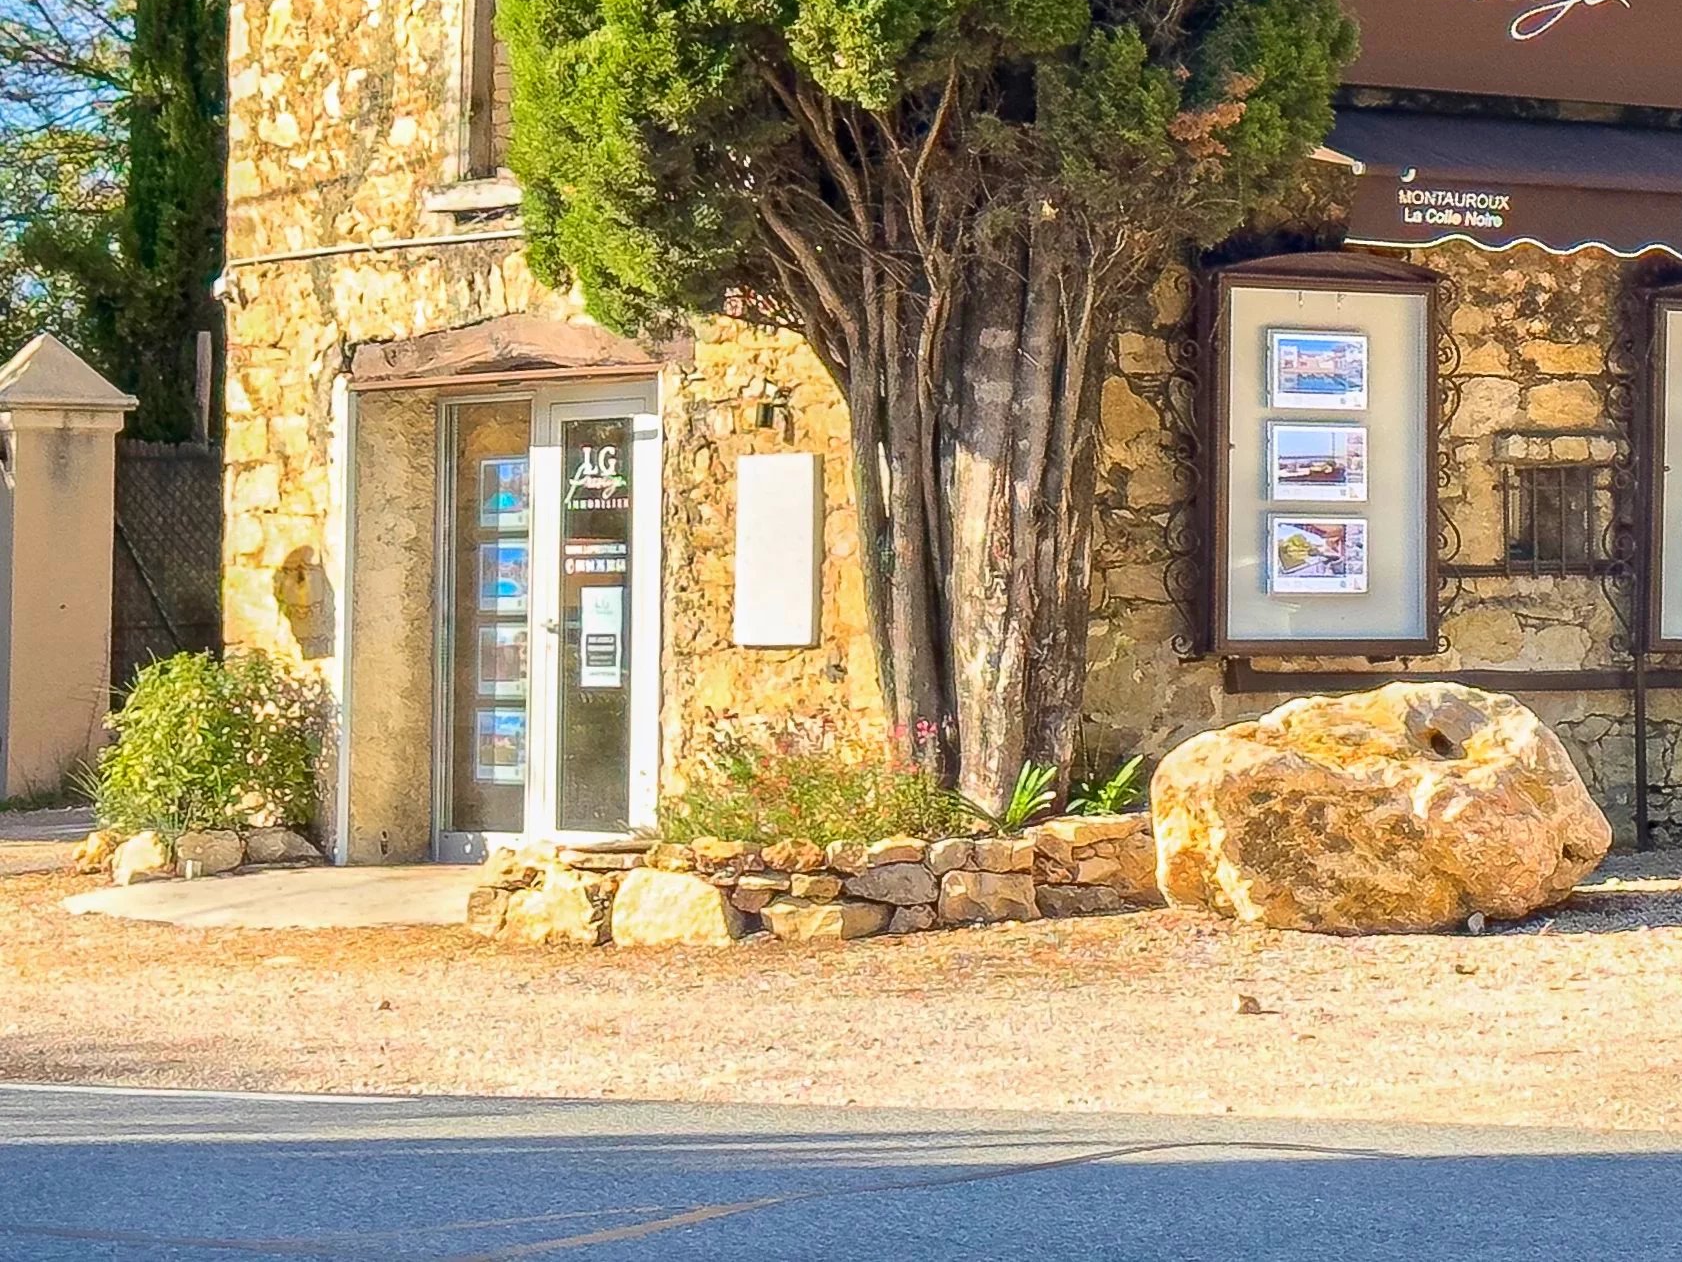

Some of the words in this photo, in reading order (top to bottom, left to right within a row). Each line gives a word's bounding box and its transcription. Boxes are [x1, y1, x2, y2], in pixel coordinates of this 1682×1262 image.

[1398, 189, 1511, 211] MONTAUROUX
[1404, 207, 1423, 223] La
[1464, 210, 1503, 228] Noire
[582, 446, 617, 476] LG
